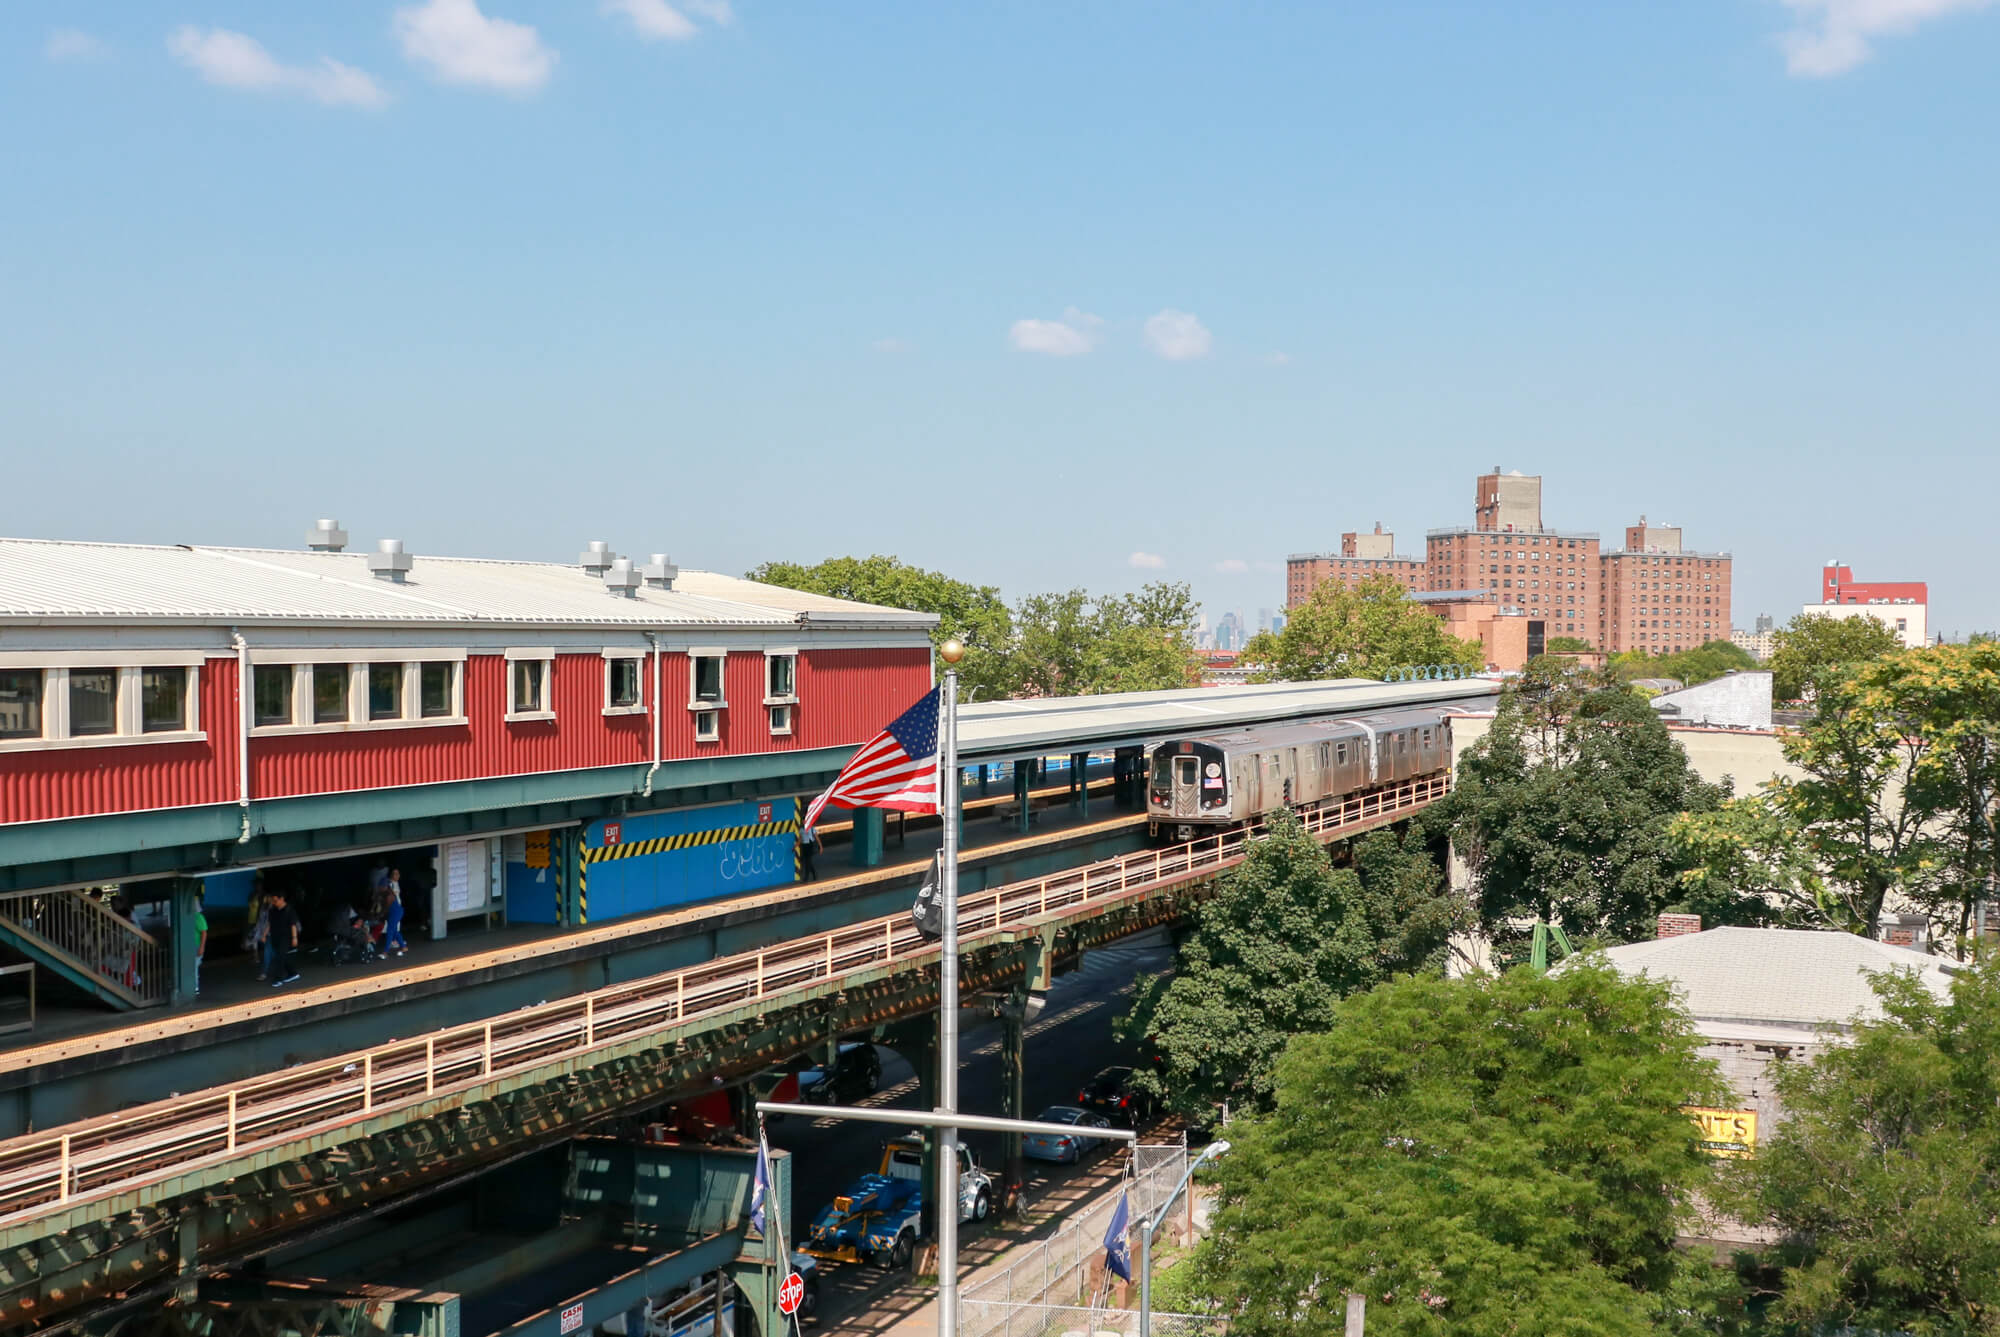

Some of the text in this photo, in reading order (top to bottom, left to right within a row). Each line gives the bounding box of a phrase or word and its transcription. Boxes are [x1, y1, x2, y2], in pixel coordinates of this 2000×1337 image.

[759, 806, 772, 816] EXIT
[605, 826, 618, 837] EXIT
[780, 1283, 802, 1304] STOP
[562, 1305, 582, 1320] CASH
